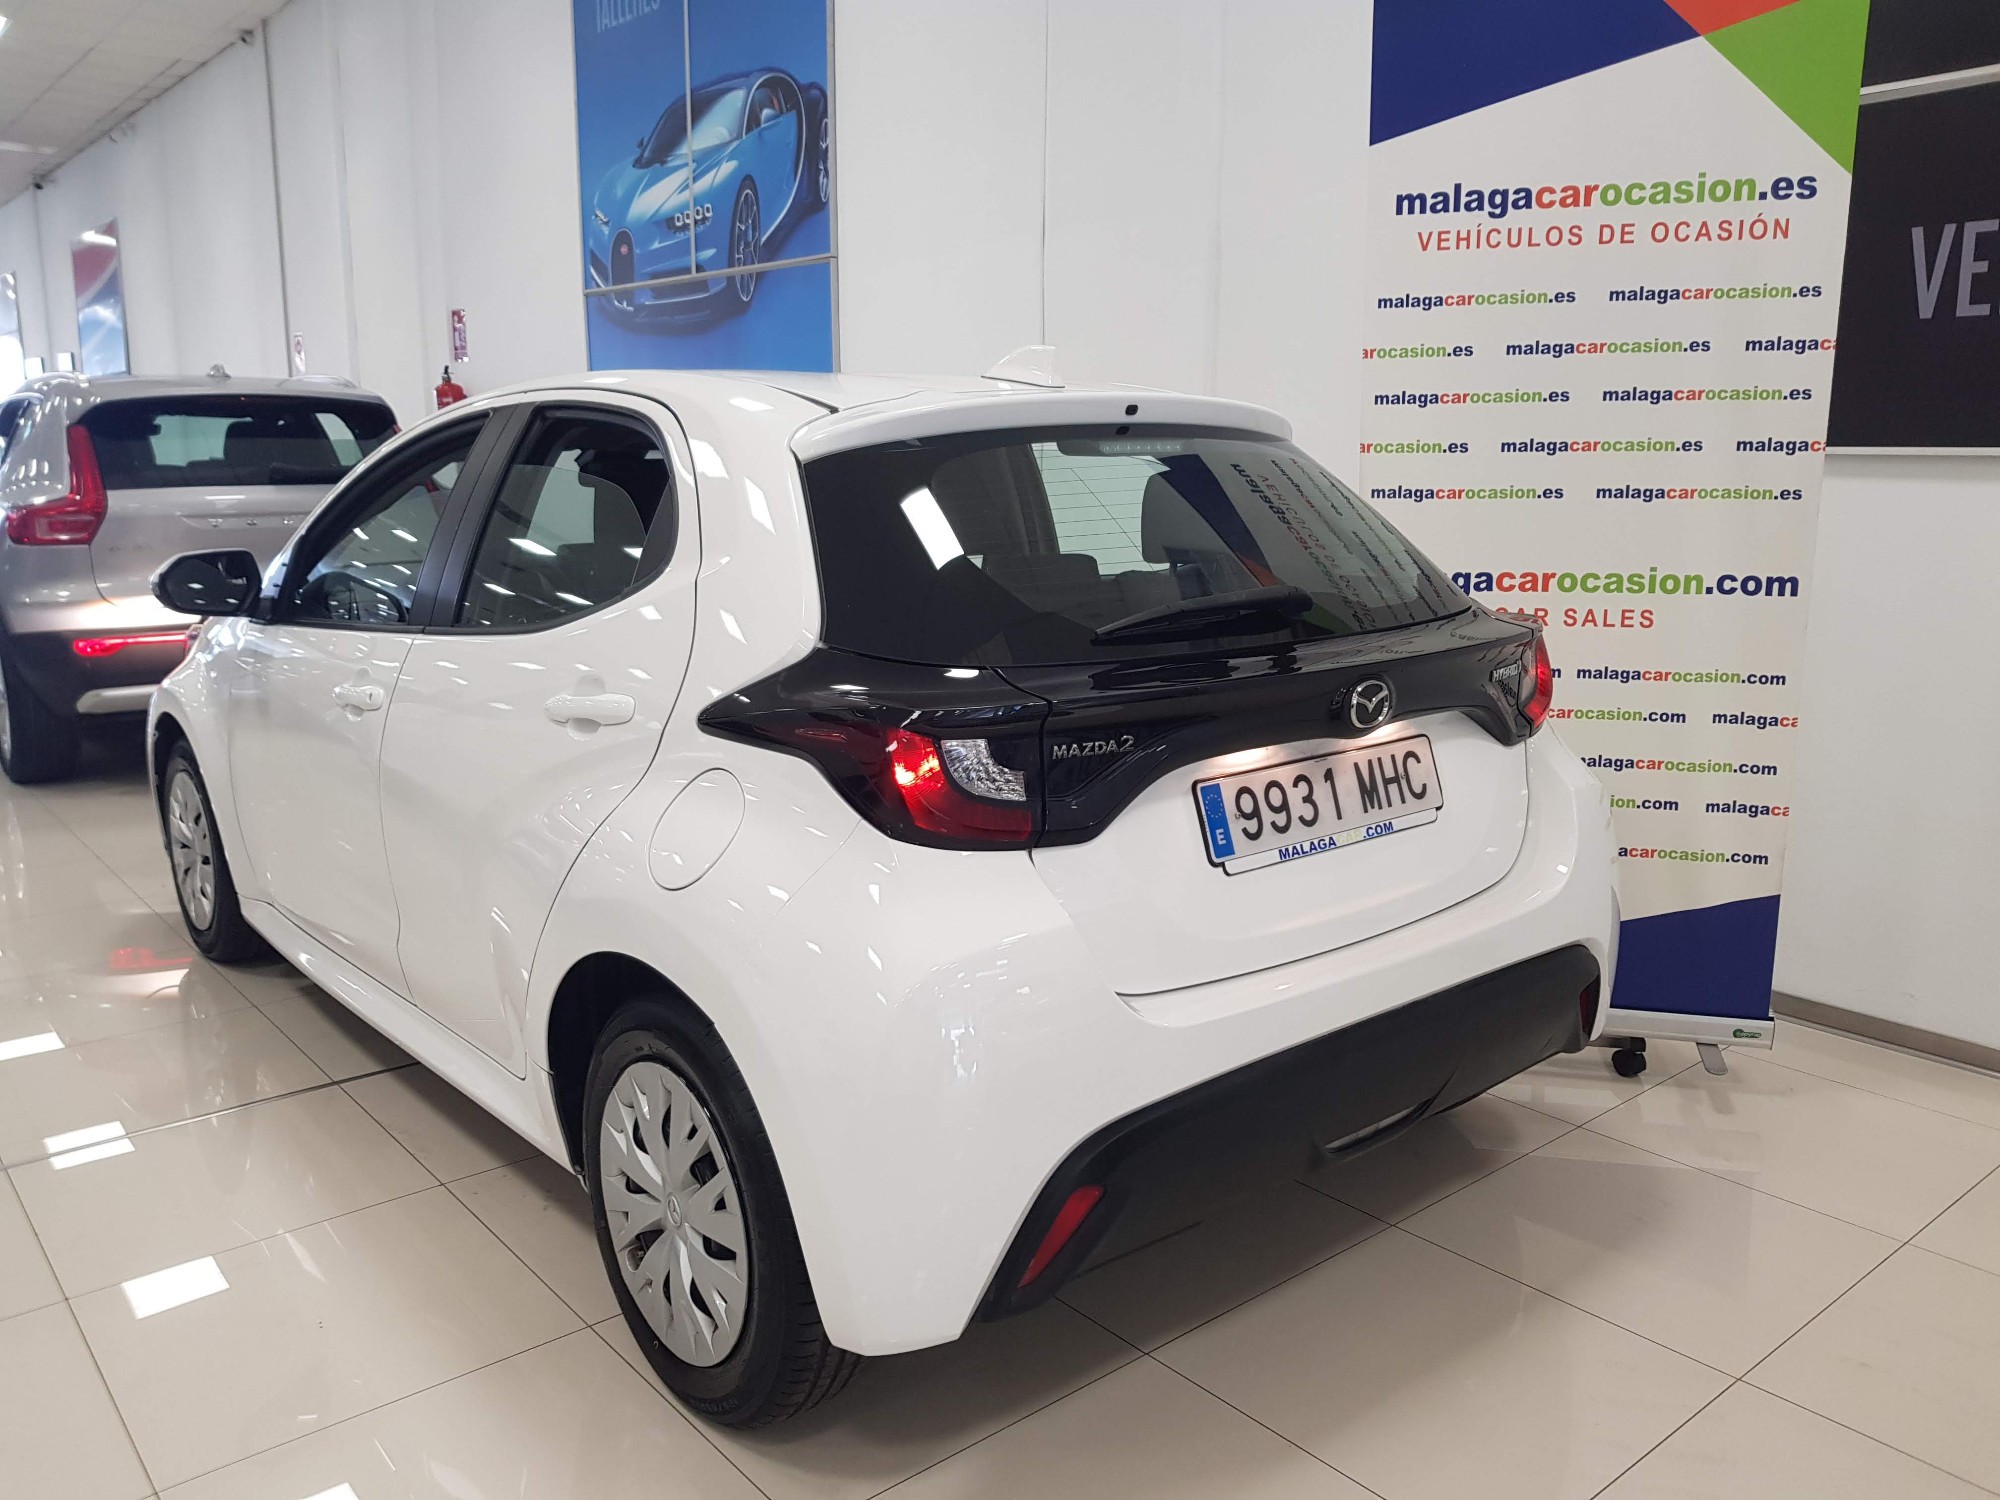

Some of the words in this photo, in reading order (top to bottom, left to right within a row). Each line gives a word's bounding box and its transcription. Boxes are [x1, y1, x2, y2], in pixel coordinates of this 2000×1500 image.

[1395, 172, 1818, 219] malagacarocasion.es
[1417, 222, 1583, 252] VEHÍCULOS
[1599, 222, 1636, 245] DE
[1650, 212, 1790, 244] OCASIÓN
[1911, 218, 2000, 319] VE
[1377, 288, 1577, 311] malagacarocasion.es
[1608, 282, 1823, 305] malagacarocasion.es
[1506, 337, 1711, 359] malagacarocasion.es
[1374, 388, 1571, 409] malagacarocasion.es
[1602, 385, 1813, 406] malagacarocasion.es
[1500, 437, 1703, 456] malagacarocasion.es
[1736, 437, 1826, 455] malagac
[1370, 484, 1565, 504] malagacarocasion.es
[1595, 485, 1803, 503] malagacarocasion.es
[1563, 608, 1654, 629] SALES
[1576, 665, 1787, 687] malagacarocasion.com
[1052, 735, 1135, 759] MAZDA2
[1581, 754, 1778, 777] alagacarocasion.com
[1234, 767, 1343, 841] 9931
[1353, 750, 1428, 814] MHC
[1215, 828, 1227, 845] E
